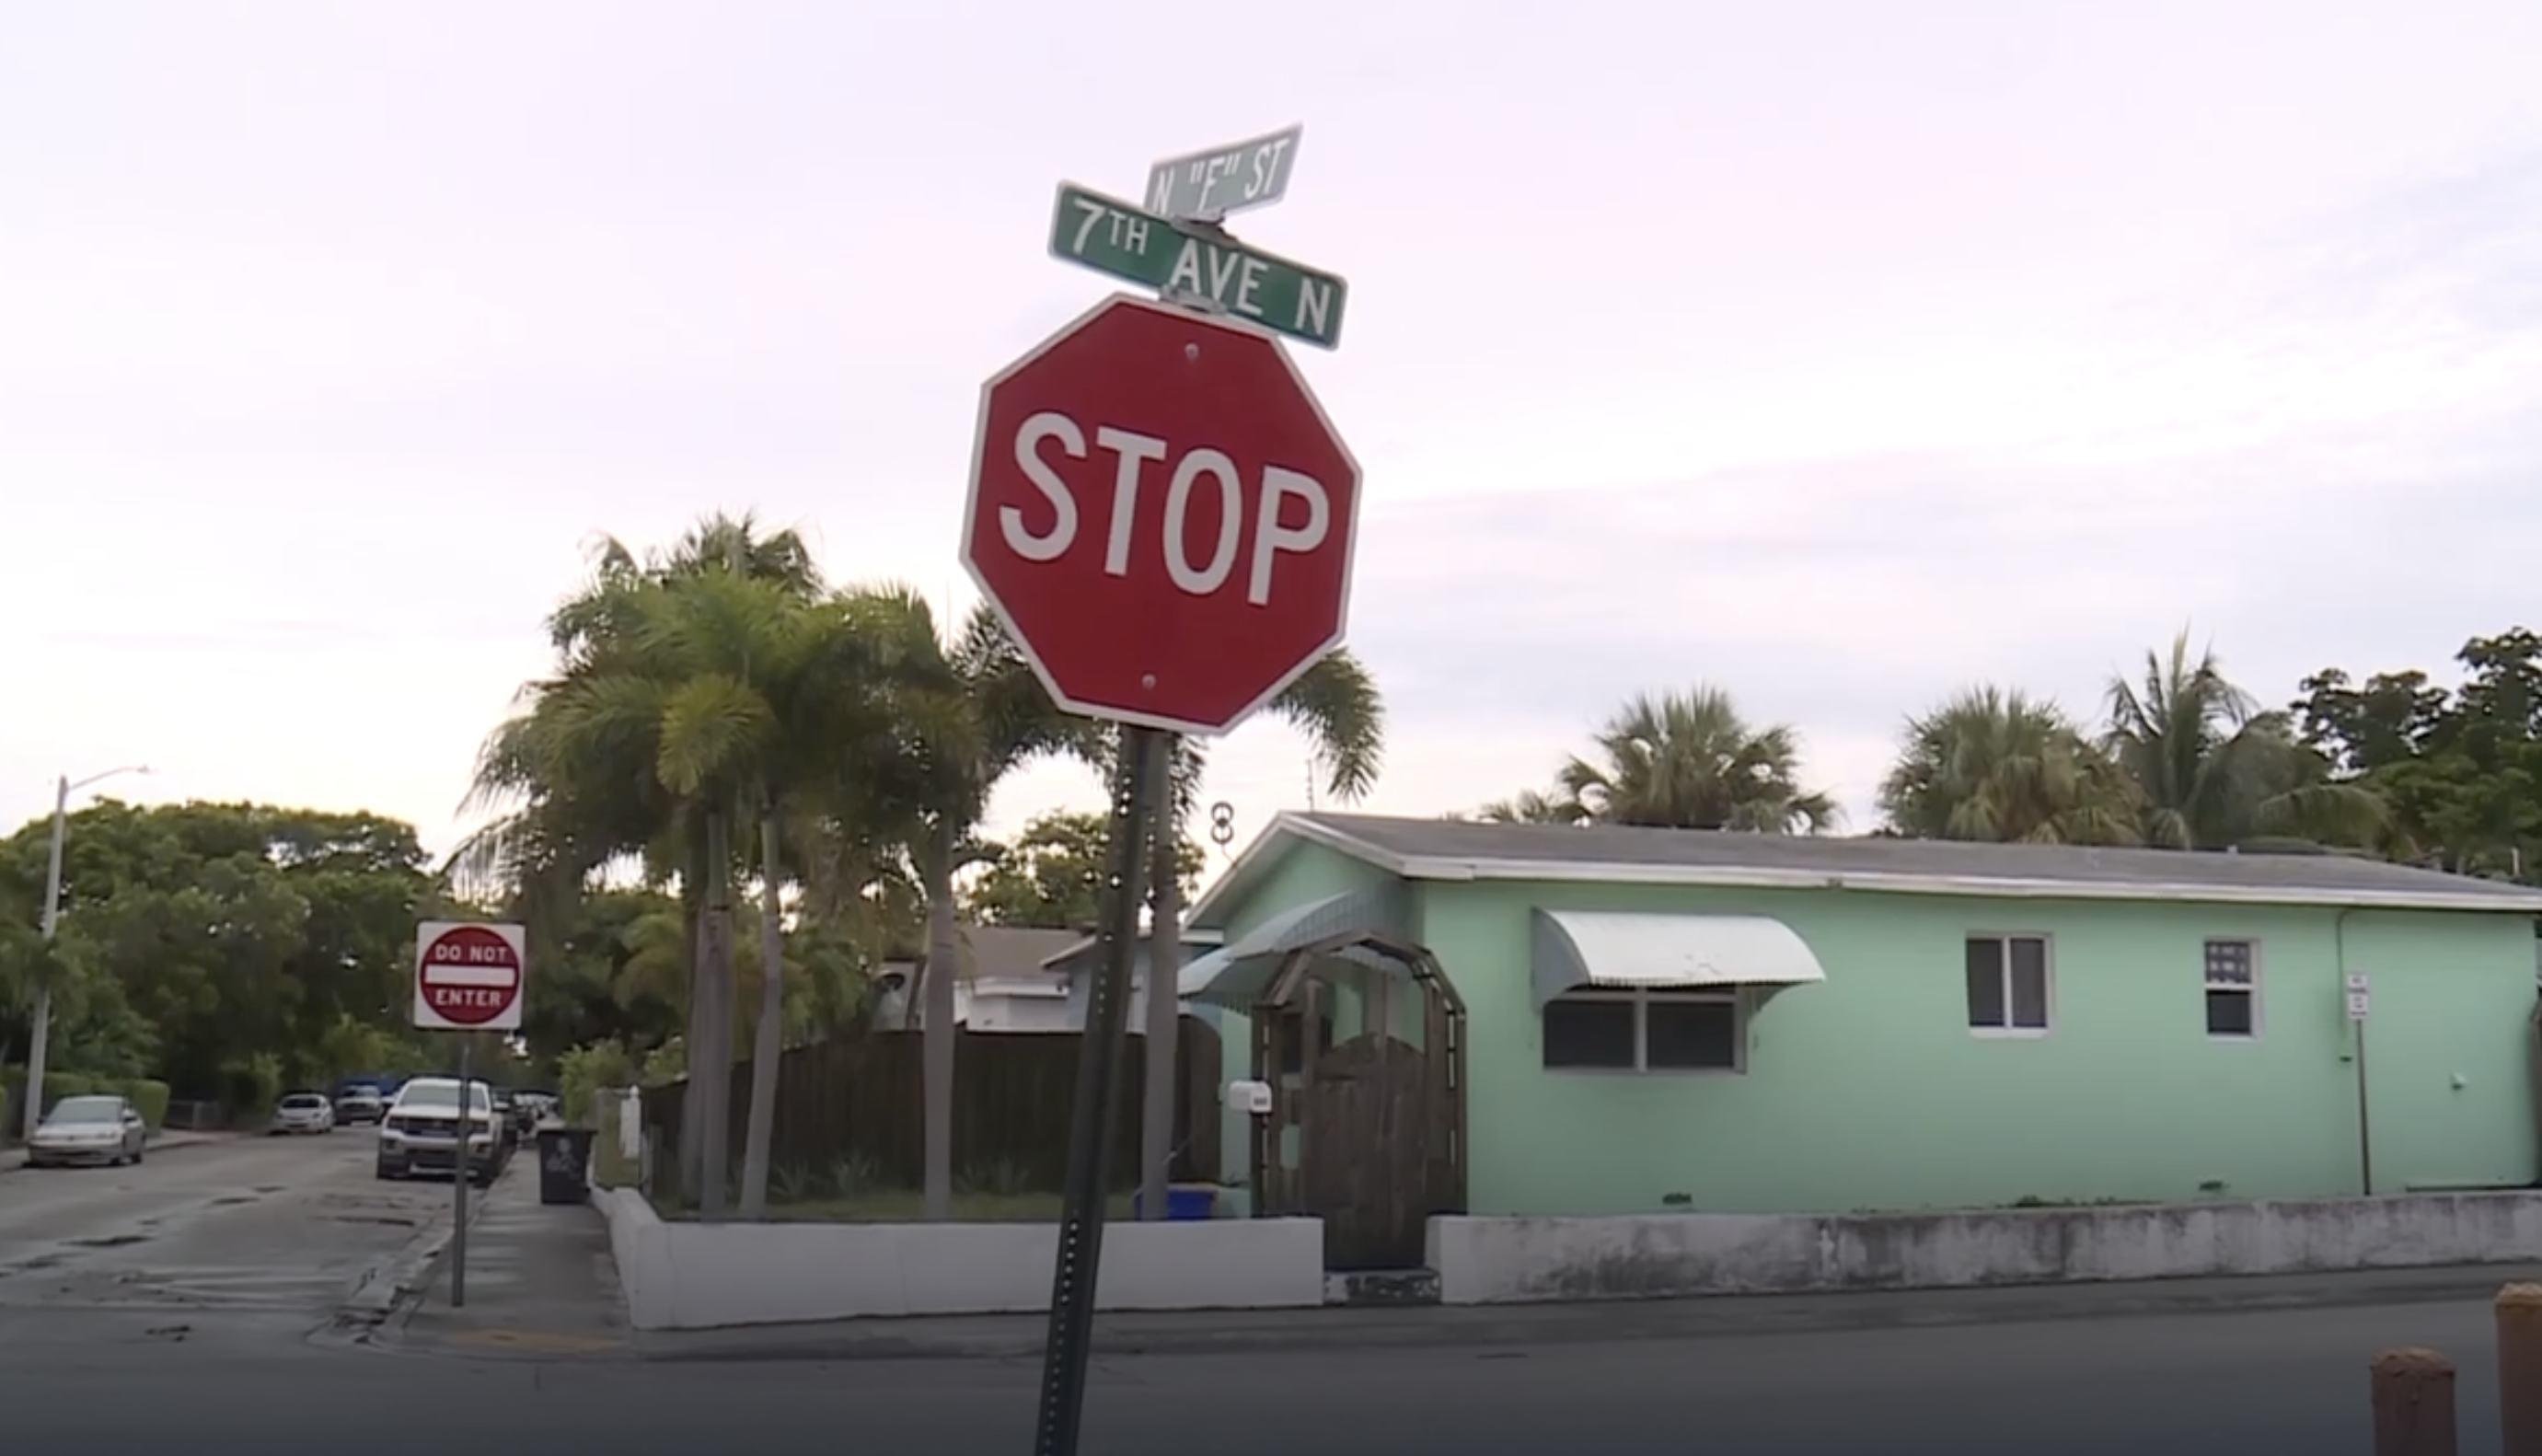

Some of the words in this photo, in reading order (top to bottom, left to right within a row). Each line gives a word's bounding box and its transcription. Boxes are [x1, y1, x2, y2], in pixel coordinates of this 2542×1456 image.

[1152, 166, 1175, 215] N
[1244, 138, 1291, 200] ST
[1072, 196, 1149, 256] 7TH
[1170, 237, 1269, 317] AVE
[1293, 277, 1332, 336] N
[999, 411, 1331, 607] STOP
[434, 943, 462, 961] DO
[469, 945, 508, 963] NOT
[435, 988, 502, 1008] ENTER
